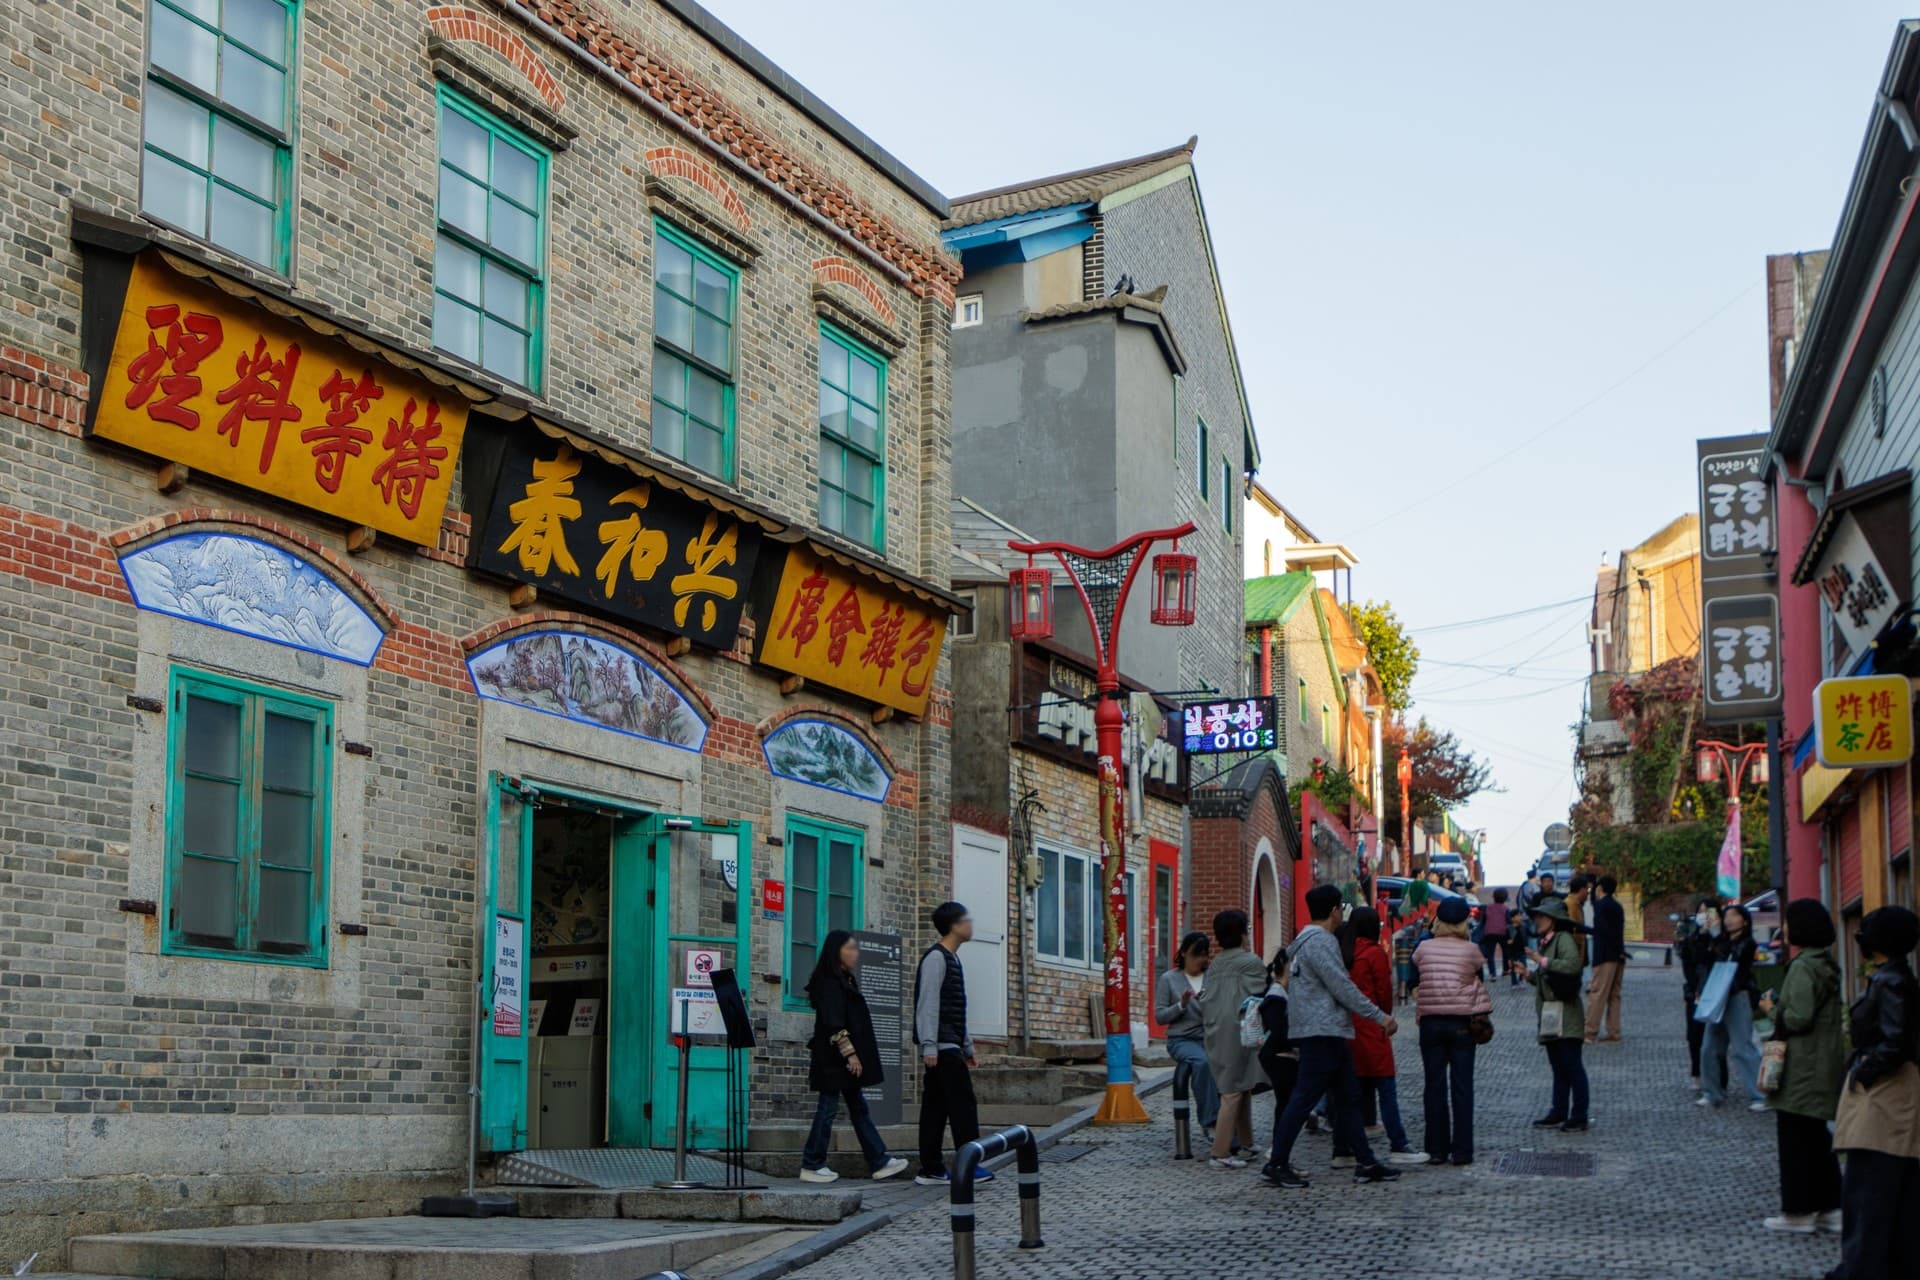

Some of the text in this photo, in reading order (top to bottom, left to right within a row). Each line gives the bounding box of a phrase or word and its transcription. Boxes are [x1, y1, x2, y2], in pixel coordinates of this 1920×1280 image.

[1708, 481, 1767, 518] 궁중
[1712, 625, 1771, 661] 궁중
[1714, 661, 1773, 698] 호떡
